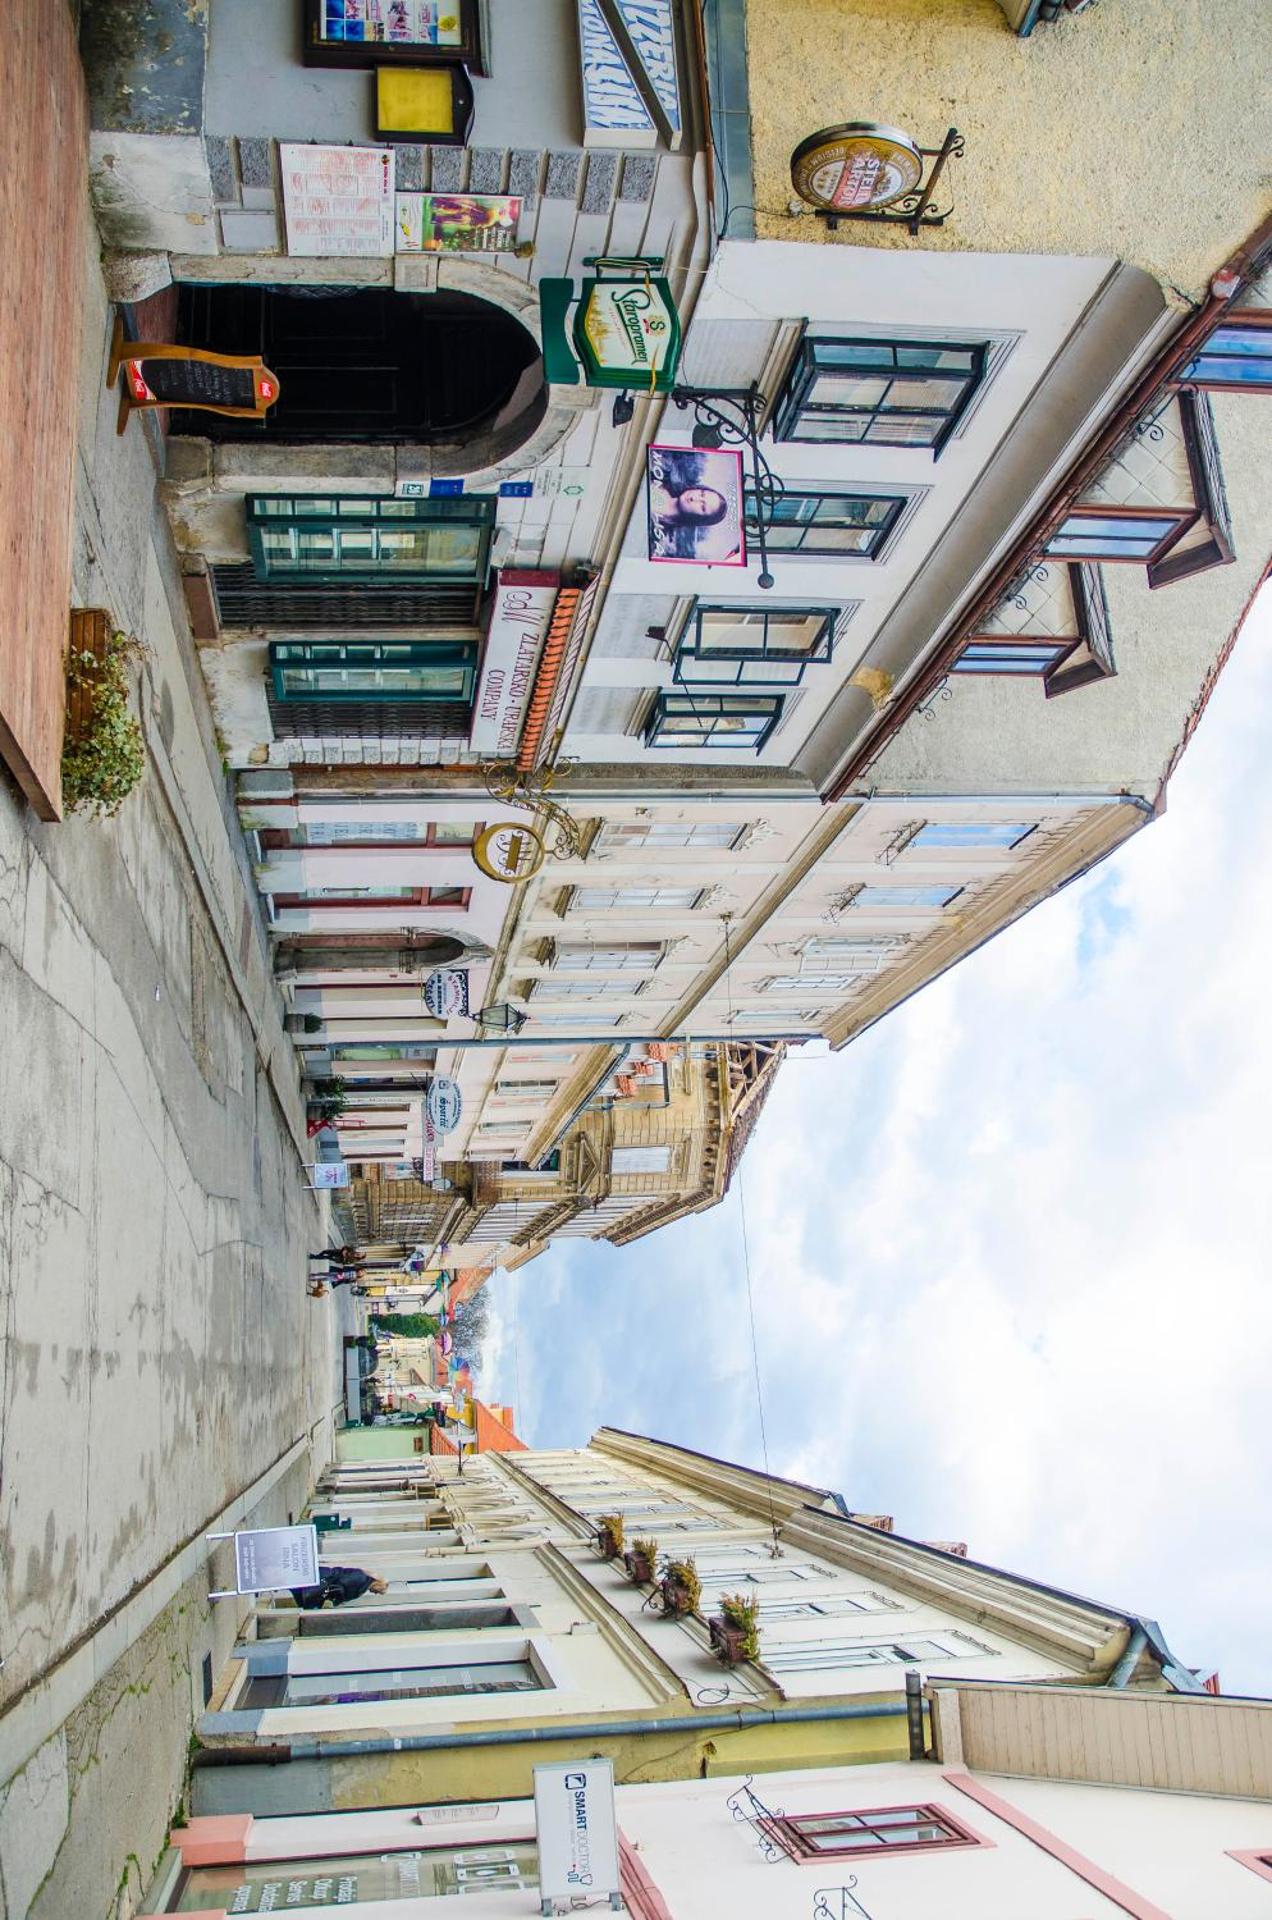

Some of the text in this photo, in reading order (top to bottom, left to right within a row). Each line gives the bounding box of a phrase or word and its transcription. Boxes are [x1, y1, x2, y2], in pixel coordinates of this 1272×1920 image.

[838, 157, 865, 207] ARTOIS
[854, 159, 881, 205] STELLA
[611, 289, 651, 365] Staropramen
[653, 513, 666, 555] LISA
[509, 633, 540, 698] ZLATARSKO
[480, 669, 507, 721] COMPANY
[497, 706, 522, 750] URARSKA
[286, 1880, 308, 1903] Servis
[333, 1876, 358, 1903] Prodaja
